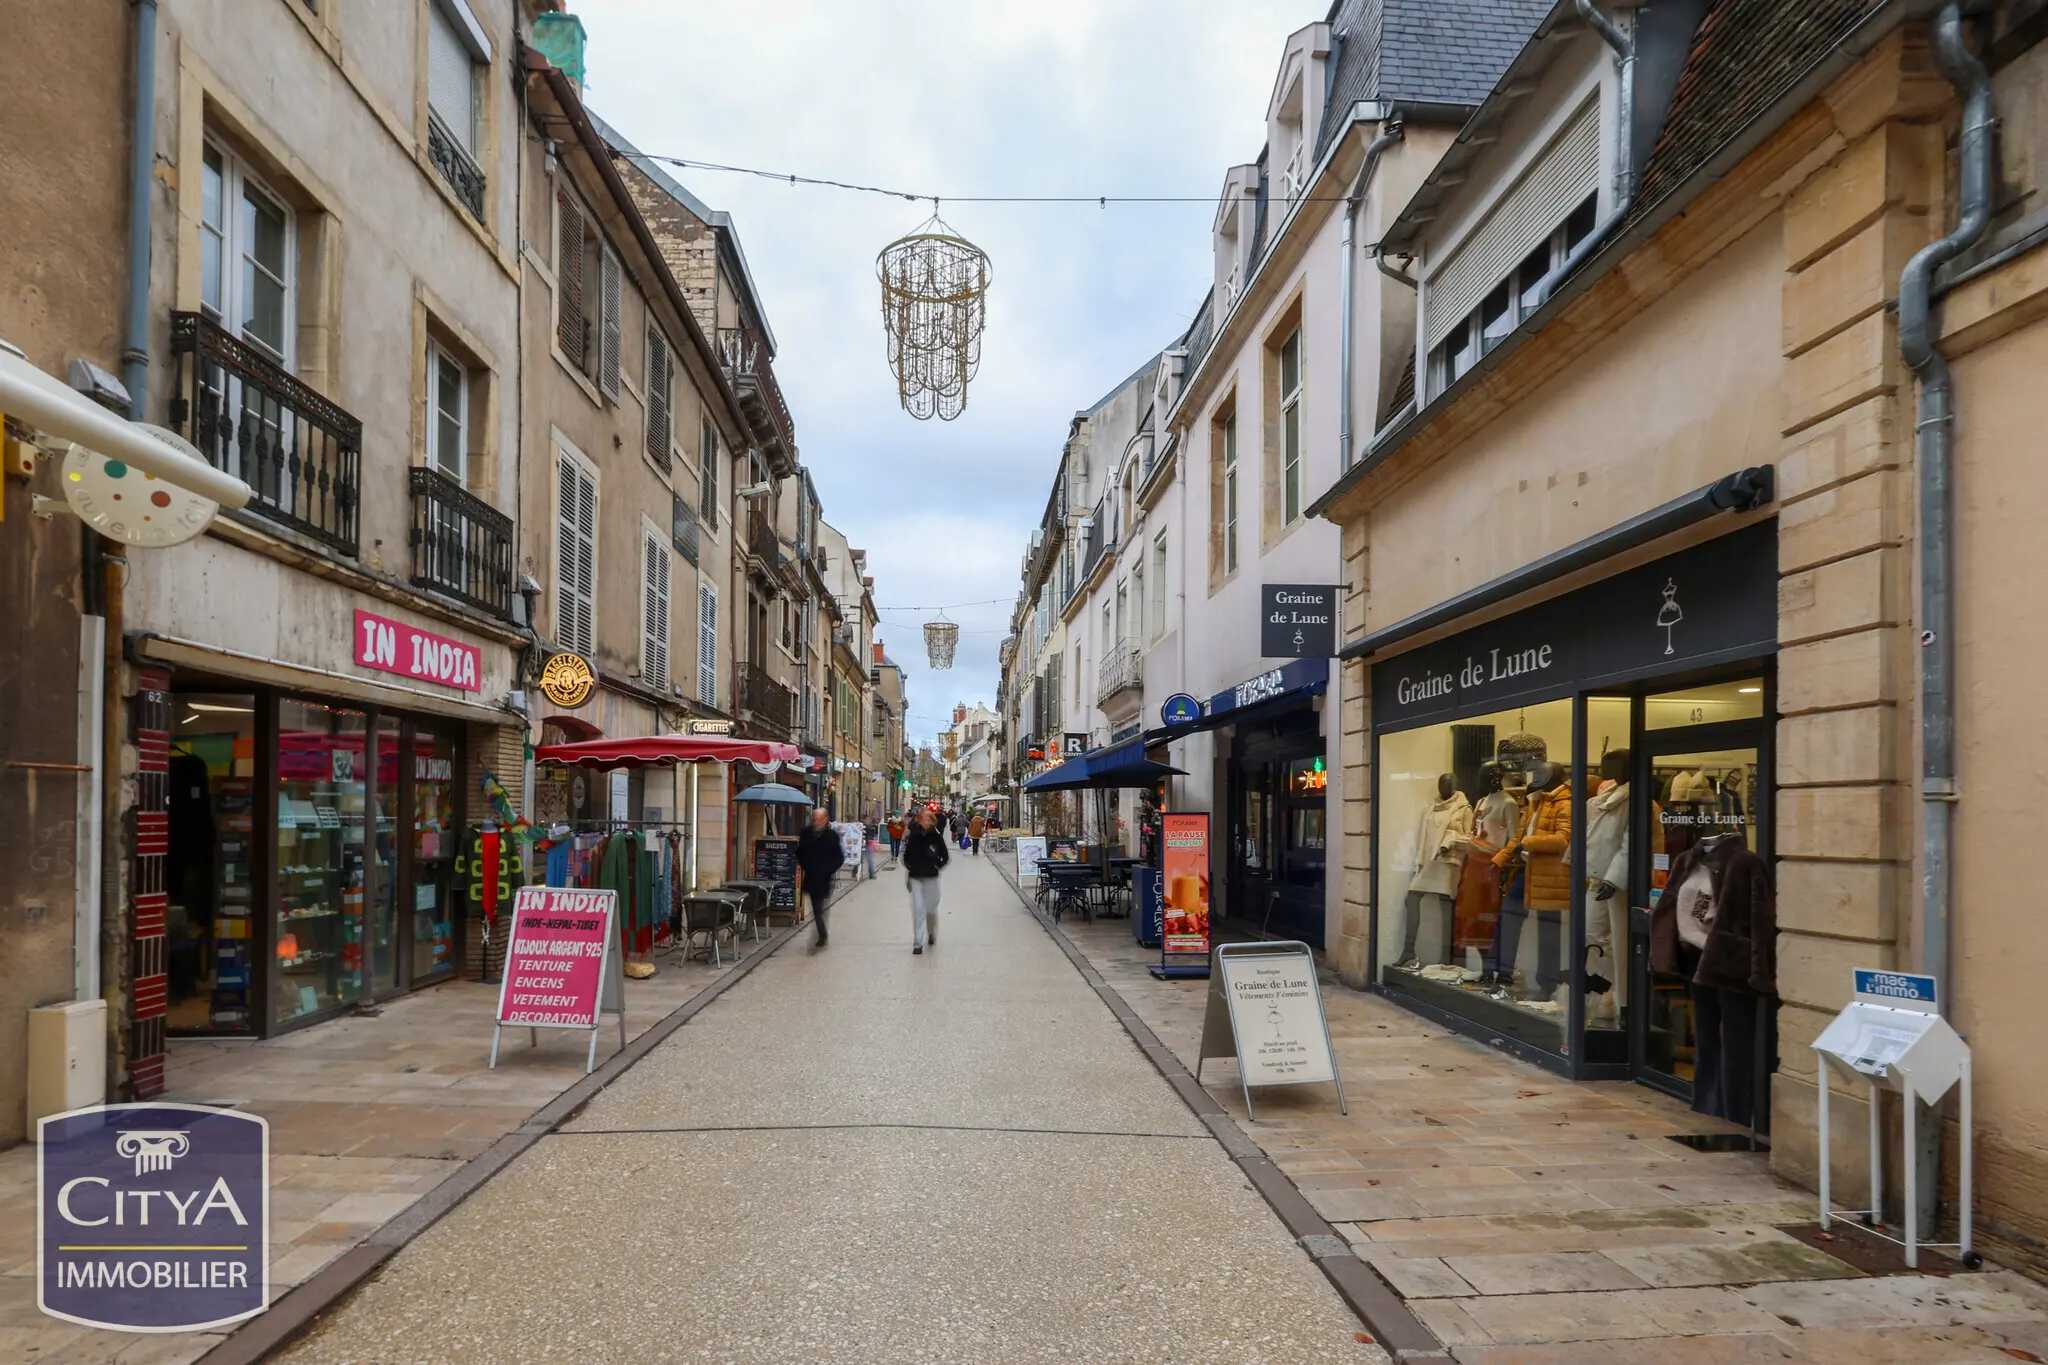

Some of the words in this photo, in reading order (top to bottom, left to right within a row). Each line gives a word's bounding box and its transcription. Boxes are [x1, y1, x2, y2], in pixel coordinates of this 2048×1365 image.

[1275, 591, 1323, 604] Graine
[1270, 611, 1287, 624] de
[1290, 611, 1328, 624] Lune
[363, 619, 396, 667] IN
[410, 634, 475, 688] INDIA
[1397, 669, 1453, 705] Graine
[1460, 657, 1484, 689] de
[1490, 643, 1552, 683] Lune
[148, 691, 162, 703] 62
[1690, 708, 1703, 723] 43
[692, 722, 729, 733] CIGARETTES
[415, 756, 426, 779] IN
[427, 758, 452, 780] INDIA
[1659, 812, 1694, 825] Graine
[1697, 811, 1711, 824] de
[1714, 812, 1745, 825] Lune
[1178, 830, 1205, 838] PAUSE
[520, 891, 546, 911] IN
[549, 892, 608, 913] INDIA
[514, 939, 549, 955] BIJOUX
[550, 941, 586, 957] ARGENT
[586, 942, 603, 958] 925
[518, 960, 573, 972] TENTURE
[514, 977, 564, 989] ENCENS
[1234, 980, 1268, 991] Graine
[1269, 980, 1281, 989] de
[1284, 979, 1309, 988] Lune
[512, 994, 578, 1007] VETEMENT
[1239, 992, 1274, 1000] Vêtements
[509, 1011, 591, 1024] DECORATION
